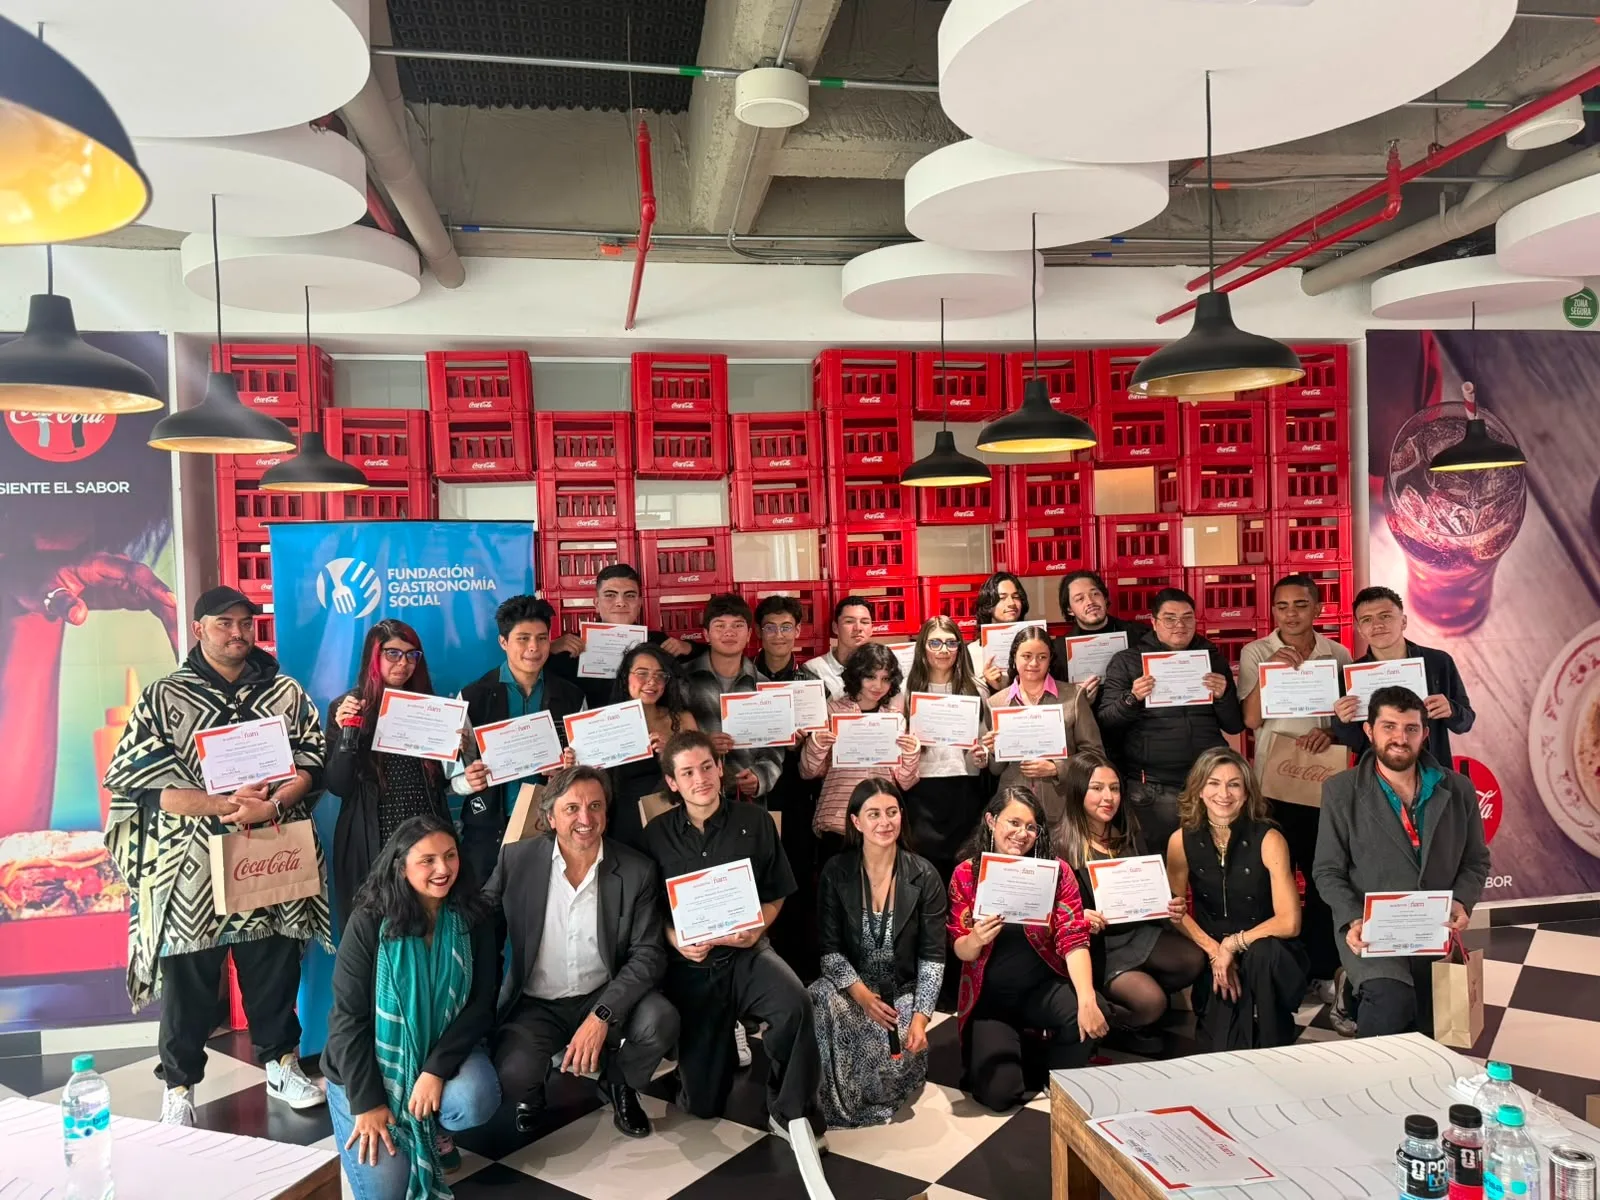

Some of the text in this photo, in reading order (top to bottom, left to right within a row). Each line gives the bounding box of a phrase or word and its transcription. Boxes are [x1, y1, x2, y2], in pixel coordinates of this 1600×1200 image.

[1574, 299, 1588, 307] ZONA
[1571, 307, 1591, 316] SEGURA
[0, 481, 130, 494] SIENTE EL SABOR
[387, 564, 474, 580] FUNDACIÓN
[388, 579, 496, 594] GASTRONOMÍA
[389, 594, 441, 607] SOCIAL
[1277, 760, 1336, 782] Coca-Col
[234, 848, 303, 882] Coca-Cola
[1484, 876, 1512, 888] BOR
